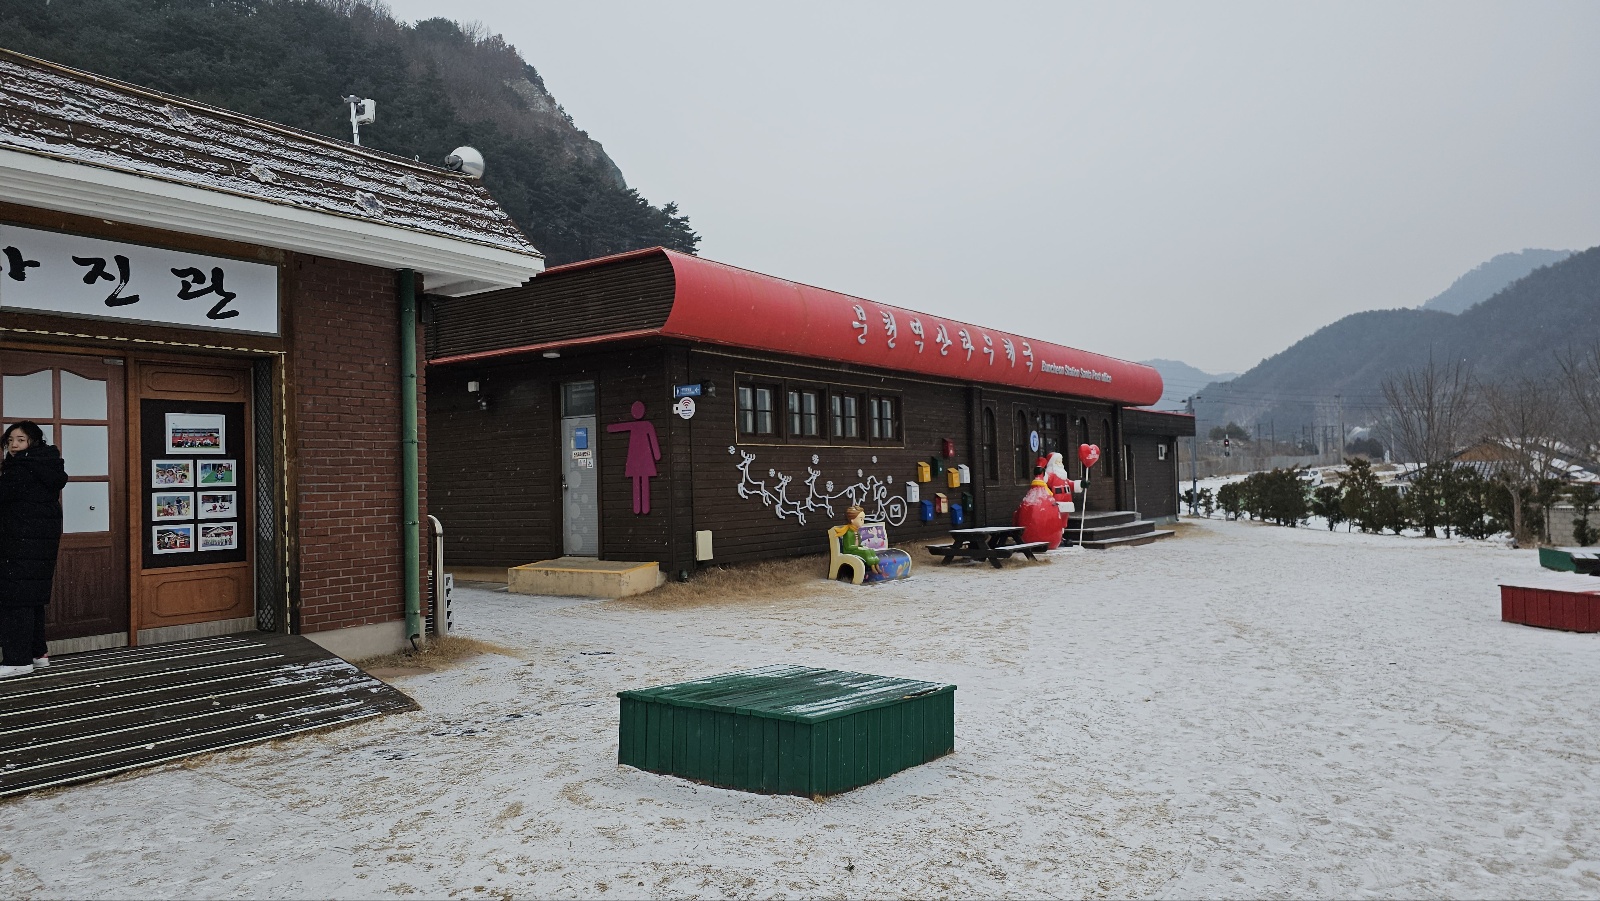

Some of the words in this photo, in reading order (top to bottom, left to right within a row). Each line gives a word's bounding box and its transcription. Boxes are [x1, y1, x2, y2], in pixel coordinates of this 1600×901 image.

[1041, 360, 1064, 375] Buncheon
[1064, 364, 1080, 378] Station
[1080, 368, 1092, 380] Santa
[1092, 369, 1101, 381] Post
